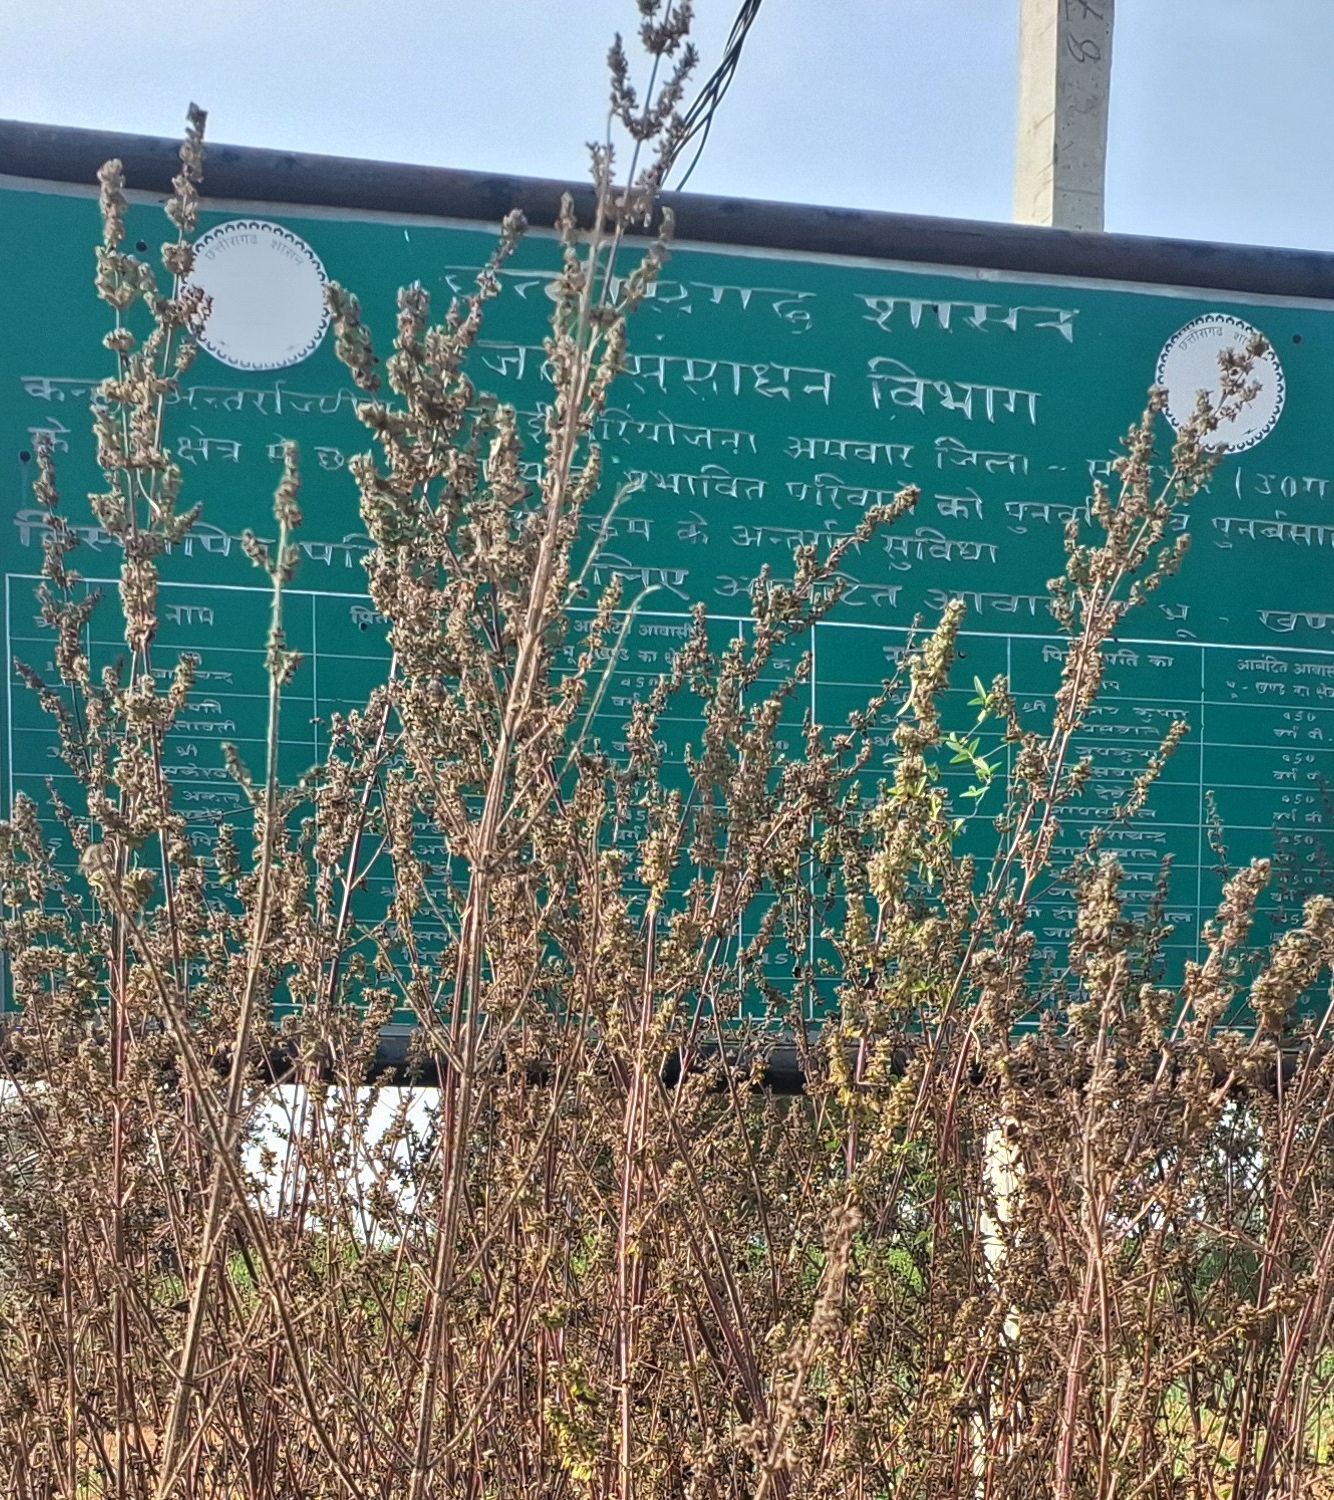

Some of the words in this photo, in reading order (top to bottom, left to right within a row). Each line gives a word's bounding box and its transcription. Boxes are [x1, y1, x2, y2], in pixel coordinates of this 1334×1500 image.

[867, 356, 1043, 426] विभाग
[934, 435, 1029, 475] जिला
[934, 487, 984, 522] को
[880, 523, 1000, 572] सुविधा
